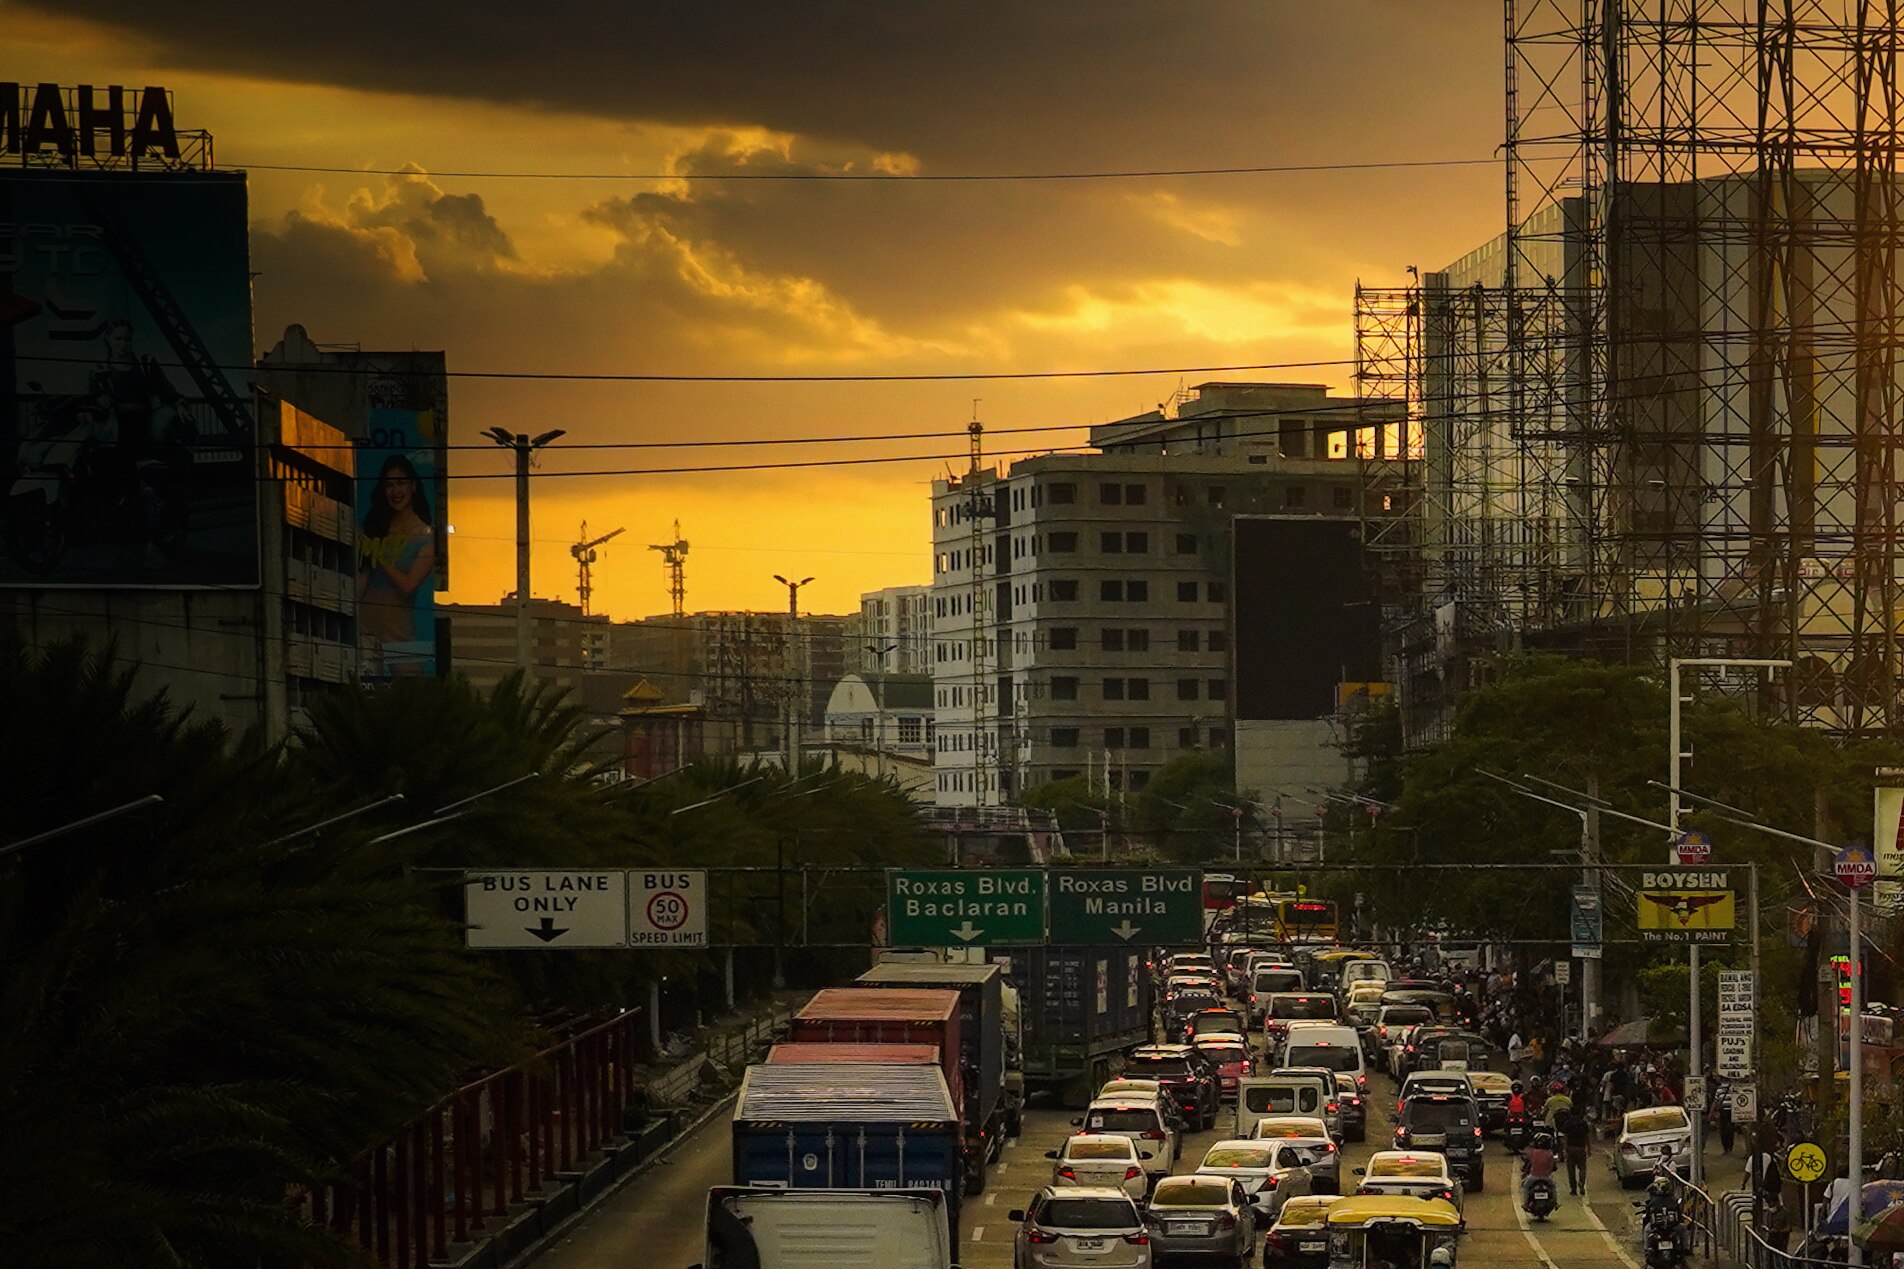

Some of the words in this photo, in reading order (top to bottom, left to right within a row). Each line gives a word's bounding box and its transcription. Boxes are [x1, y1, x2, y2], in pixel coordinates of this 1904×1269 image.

[1679, 846, 1709, 854] MMDA
[1837, 863, 1874, 874] MMDA
[484, 876, 531, 891] BUS
[546, 876, 609, 891] LANE
[644, 874, 691, 889] BUS
[896, 877, 966, 896] Roxas
[978, 876, 1037, 896] Blvd.
[1059, 875, 1129, 894] Roxas
[1141, 875, 1193, 894] Blvd
[1642, 872, 1728, 889] BOYSEN
[514, 896, 579, 912] ONLY
[656, 899, 680, 914] 50
[906, 899, 1028, 917] Baclaran
[1085, 897, 1167, 915] Manila
[656, 915, 678, 924] MAX
[632, 932, 668, 944] SPEED
[673, 932, 704, 944] LIMIT
[1643, 931, 1663, 941] The
[1695, 931, 1728, 941] PAINT
